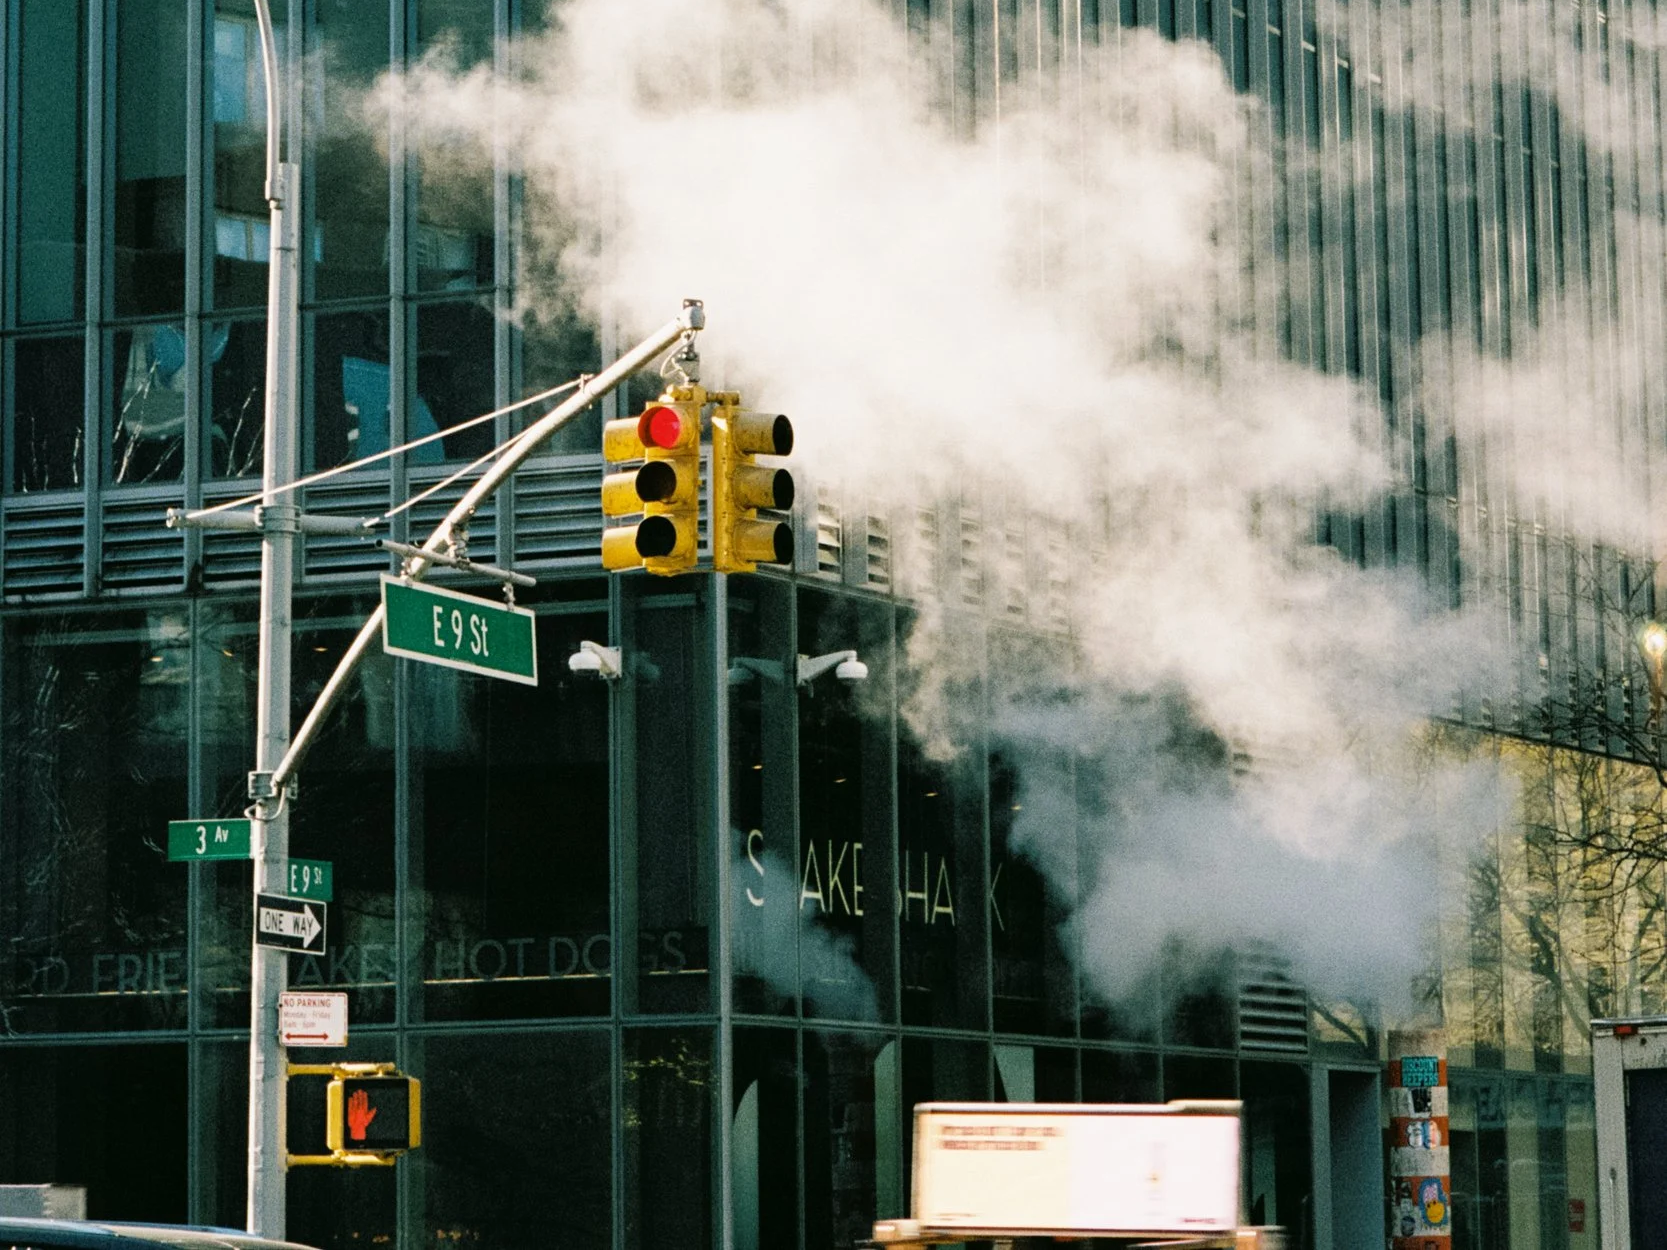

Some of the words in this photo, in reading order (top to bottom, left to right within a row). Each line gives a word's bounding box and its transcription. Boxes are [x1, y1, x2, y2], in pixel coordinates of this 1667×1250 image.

[433, 605, 445, 647] E
[451, 609, 463, 650] 9
[470, 614, 489, 657] St
[195, 825, 207, 854] 3
[214, 825, 229, 843] Av
[290, 864, 298, 893] E
[302, 866, 310, 893] 9
[313, 867, 322, 884] St
[746, 829, 864, 917] SAKE
[897, 845, 1004, 931] HAK
[264, 911, 284, 932] ONE
[292, 916, 313, 936] WAY
[93, 951, 182, 992] FRIE
[435, 937, 535, 980] HOT
[284, 998, 295, 1008] NO
[297, 998, 331, 1008] PARKING
